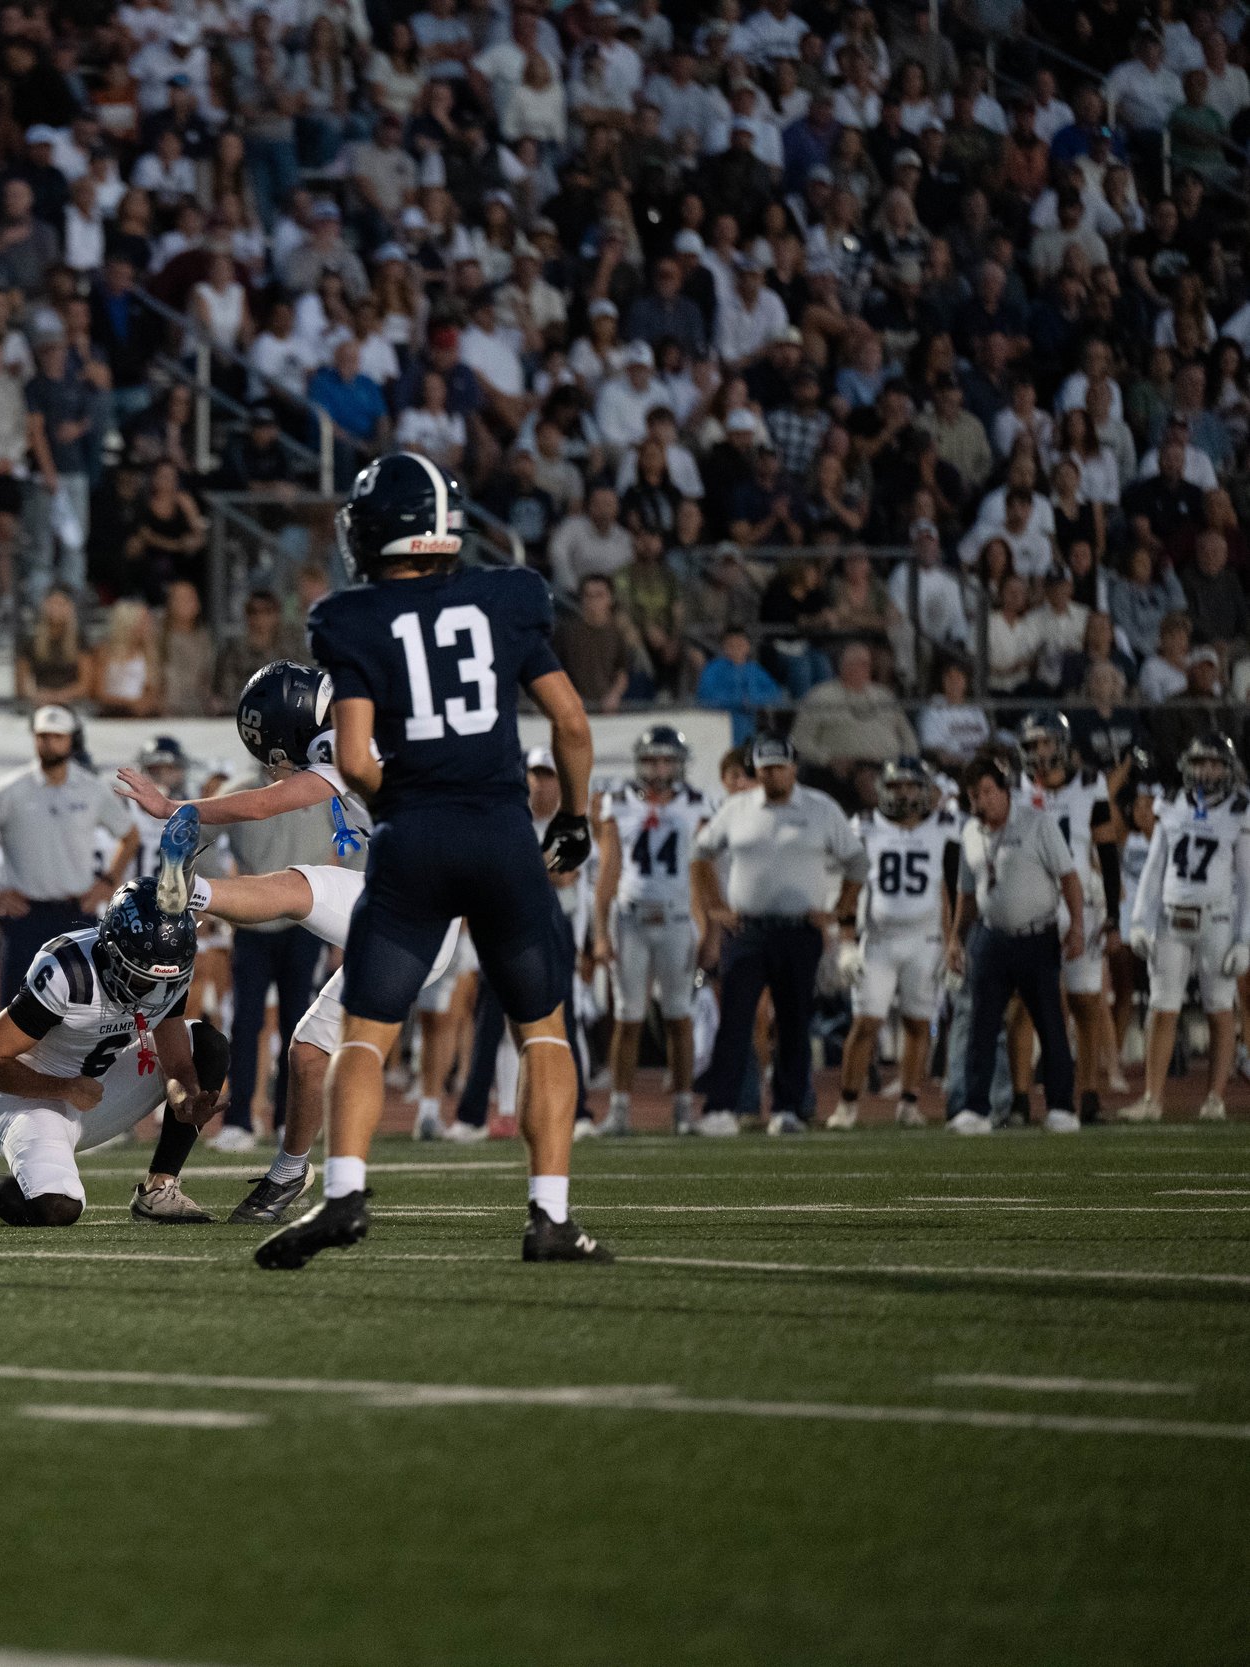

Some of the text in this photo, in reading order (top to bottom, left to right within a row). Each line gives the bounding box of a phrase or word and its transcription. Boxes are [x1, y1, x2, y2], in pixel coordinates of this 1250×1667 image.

[391, 604, 499, 741] 13
[241, 705, 262, 746] 35
[631, 828, 678, 876] 44
[879, 851, 940, 896] 85
[1173, 833, 1220, 882] 47
[33, 964, 55, 993] 6
[99, 1020, 151, 1034] CHAMPIN
[80, 1032, 132, 1078] 6
